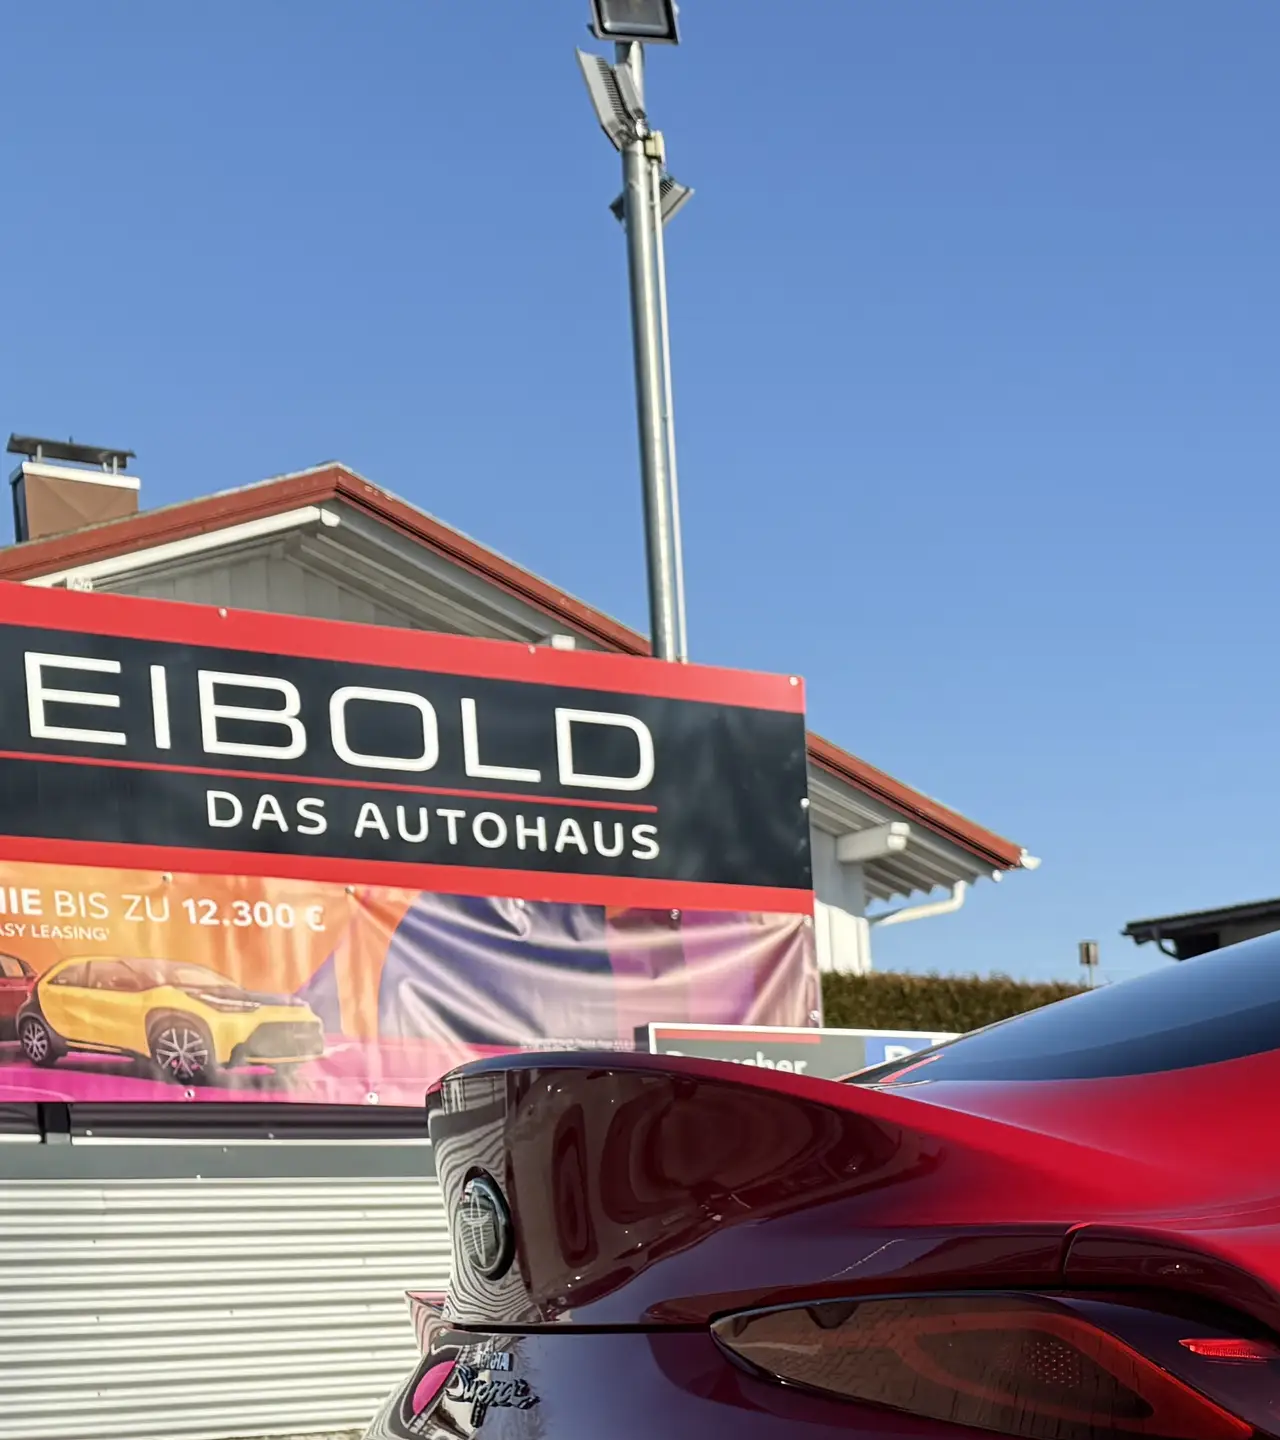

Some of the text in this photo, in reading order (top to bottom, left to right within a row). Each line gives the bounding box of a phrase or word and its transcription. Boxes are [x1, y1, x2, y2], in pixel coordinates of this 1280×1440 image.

[25, 651, 654, 791] EIBOLD
[206, 791, 660, 860] DAS AUTOHAUS
[54, 889, 109, 919] BIS
[122, 893, 170, 922] ZU
[182, 898, 295, 929] 12.300
[306, 905, 326, 931] €
[446, 1365, 540, 1428] Supra
